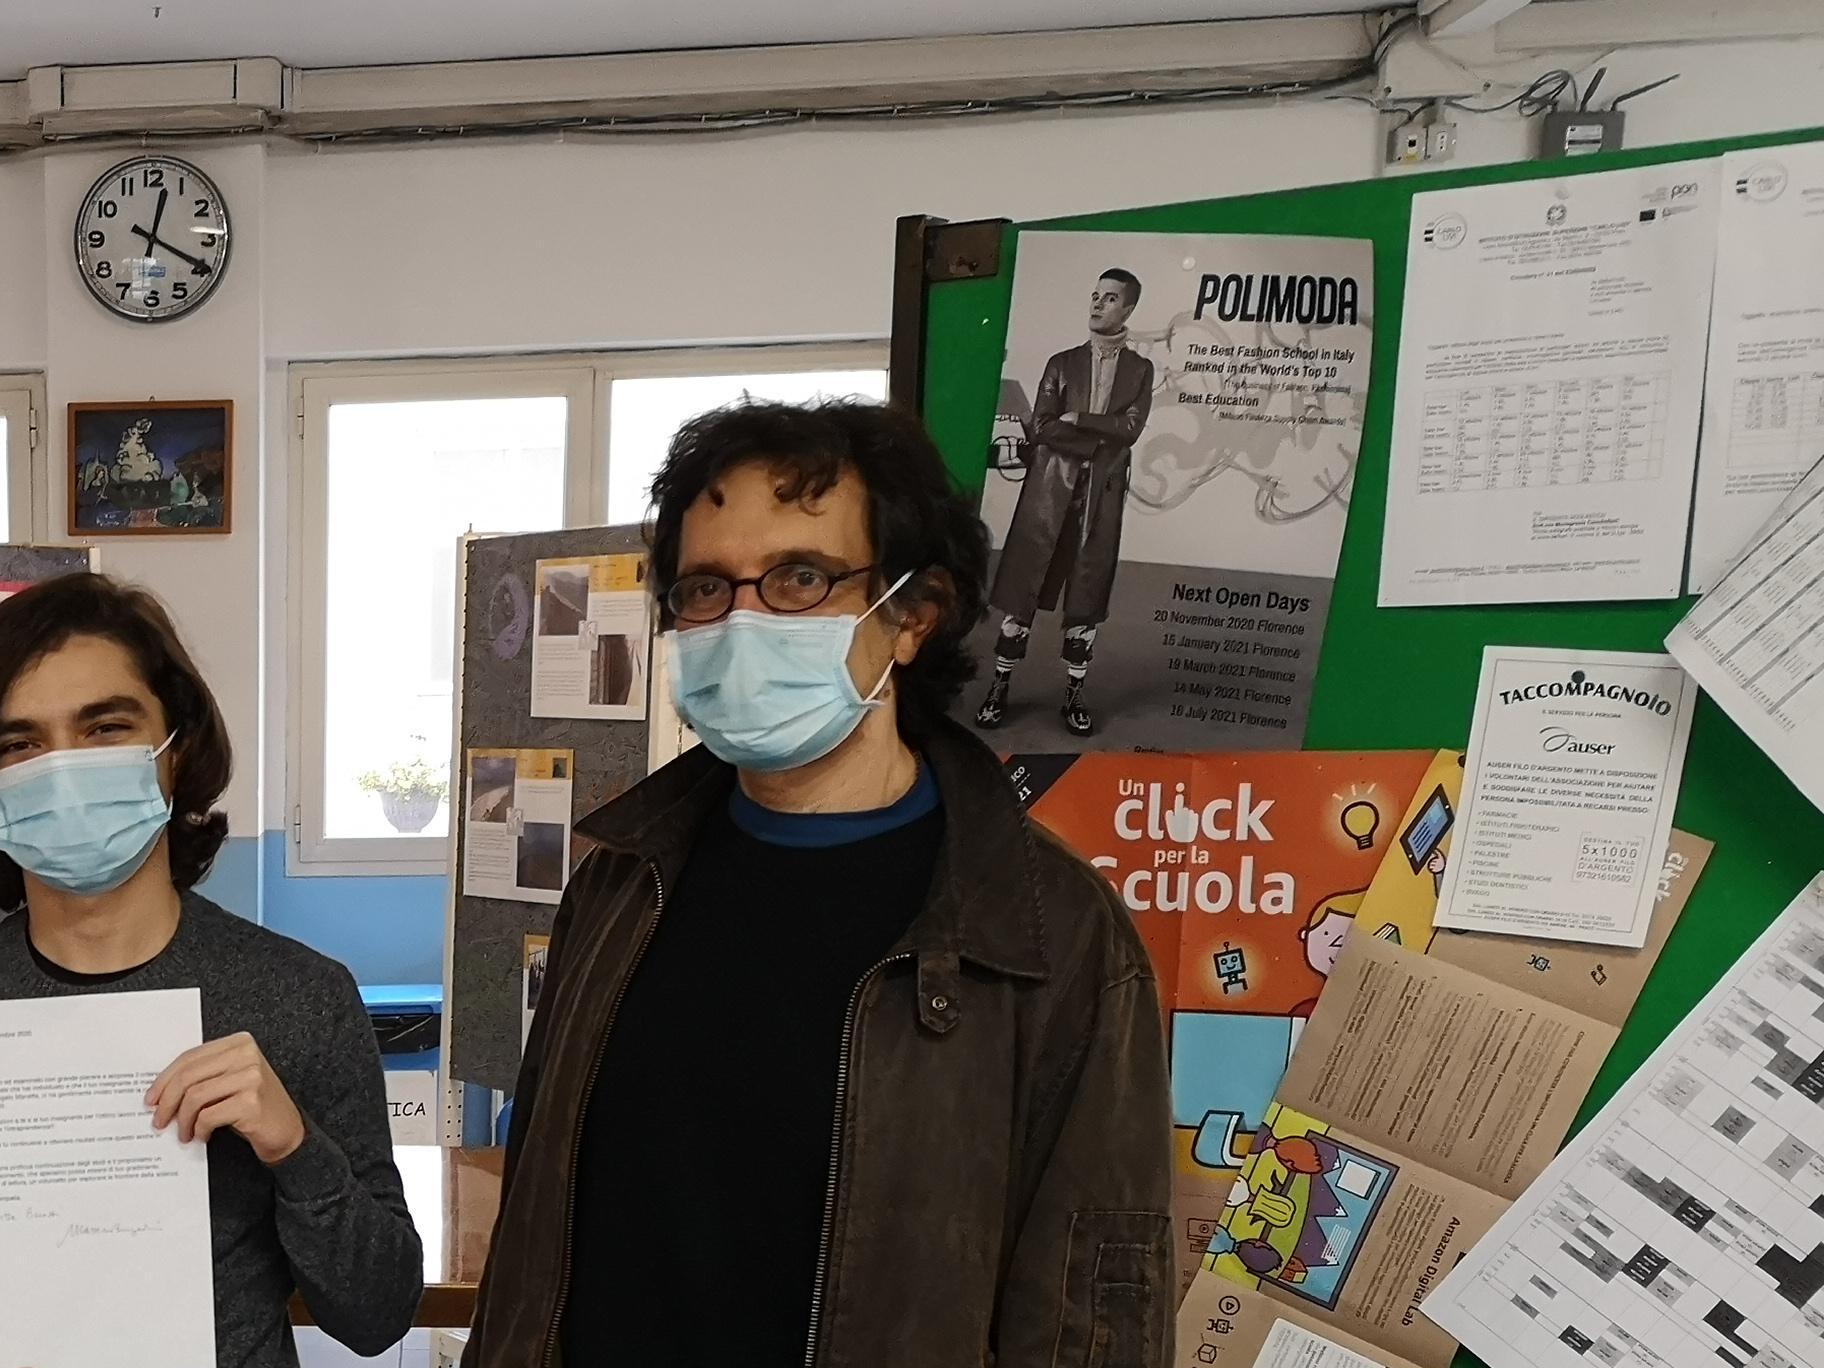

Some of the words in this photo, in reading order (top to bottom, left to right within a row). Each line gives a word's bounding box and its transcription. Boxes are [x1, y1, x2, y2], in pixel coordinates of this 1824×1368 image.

[121, 177, 133, 196] 11
[143, 169, 164, 188] 12
[179, 177, 184, 196] 1
[98, 201, 118, 218] 10
[194, 200, 210, 217] 2
[88, 230, 105, 248] 9
[200, 232, 216, 247] 3
[95, 261, 112, 278] 8
[115, 283, 131, 300] 7
[143, 290, 160, 307] 6
[171, 282, 188, 299] 5
[1193, 273, 1358, 326] POLIMODA
[1188, 344, 1207, 356] The
[1210, 344, 1235, 357] Best
[1236, 346, 1280, 360] Fashion
[1281, 346, 1318, 361] School
[1320, 349, 1331, 361] in
[1333, 349, 1355, 364] Italy
[1183, 361, 1224, 374] Ranked
[1227, 363, 1237, 374] in
[1239, 363, 1257, 375] the
[1259, 364, 1299, 376] World's
[1302, 366, 1321, 379] Top
[1325, 366, 1337, 378] 10
[1178, 392, 1202, 404] Best
[1205, 393, 1259, 407] Education
[1172, 583, 1212, 604] Next
[1215, 587, 1260, 608] Open
[1266, 591, 1310, 615] Days
[1153, 610, 1168, 622] 20
[1170, 610, 1225, 628] November
[1226, 616, 1255, 630] 2020
[1257, 619, 1305, 635] Florence
[1177, 635, 1221, 653] January
[1223, 640, 1249, 655] 2021
[1252, 642, 1300, 659] Florence
[1183, 658, 1216, 674] March
[1218, 663, 1246, 677] 2021
[1248, 666, 1296, 682] Florence
[1189, 683, 1212, 698] May
[1214, 686, 1240, 700] 2021
[1244, 689, 1292, 706] Florence
[1185, 706, 1208, 722] July
[1210, 709, 1236, 723] 2021
[1239, 712, 1287, 729] Florence
[1567, 741, 1616, 755] auser
[1118, 778, 1145, 796] Un
[1114, 782, 1276, 843] click
[1154, 848, 1186, 867] per
[1191, 845, 1209, 865] la
[1431, 1216, 1461, 1264] Amazon
[1413, 1265, 1438, 1305] Digital
[1401, 1304, 1419, 1326] Lab
